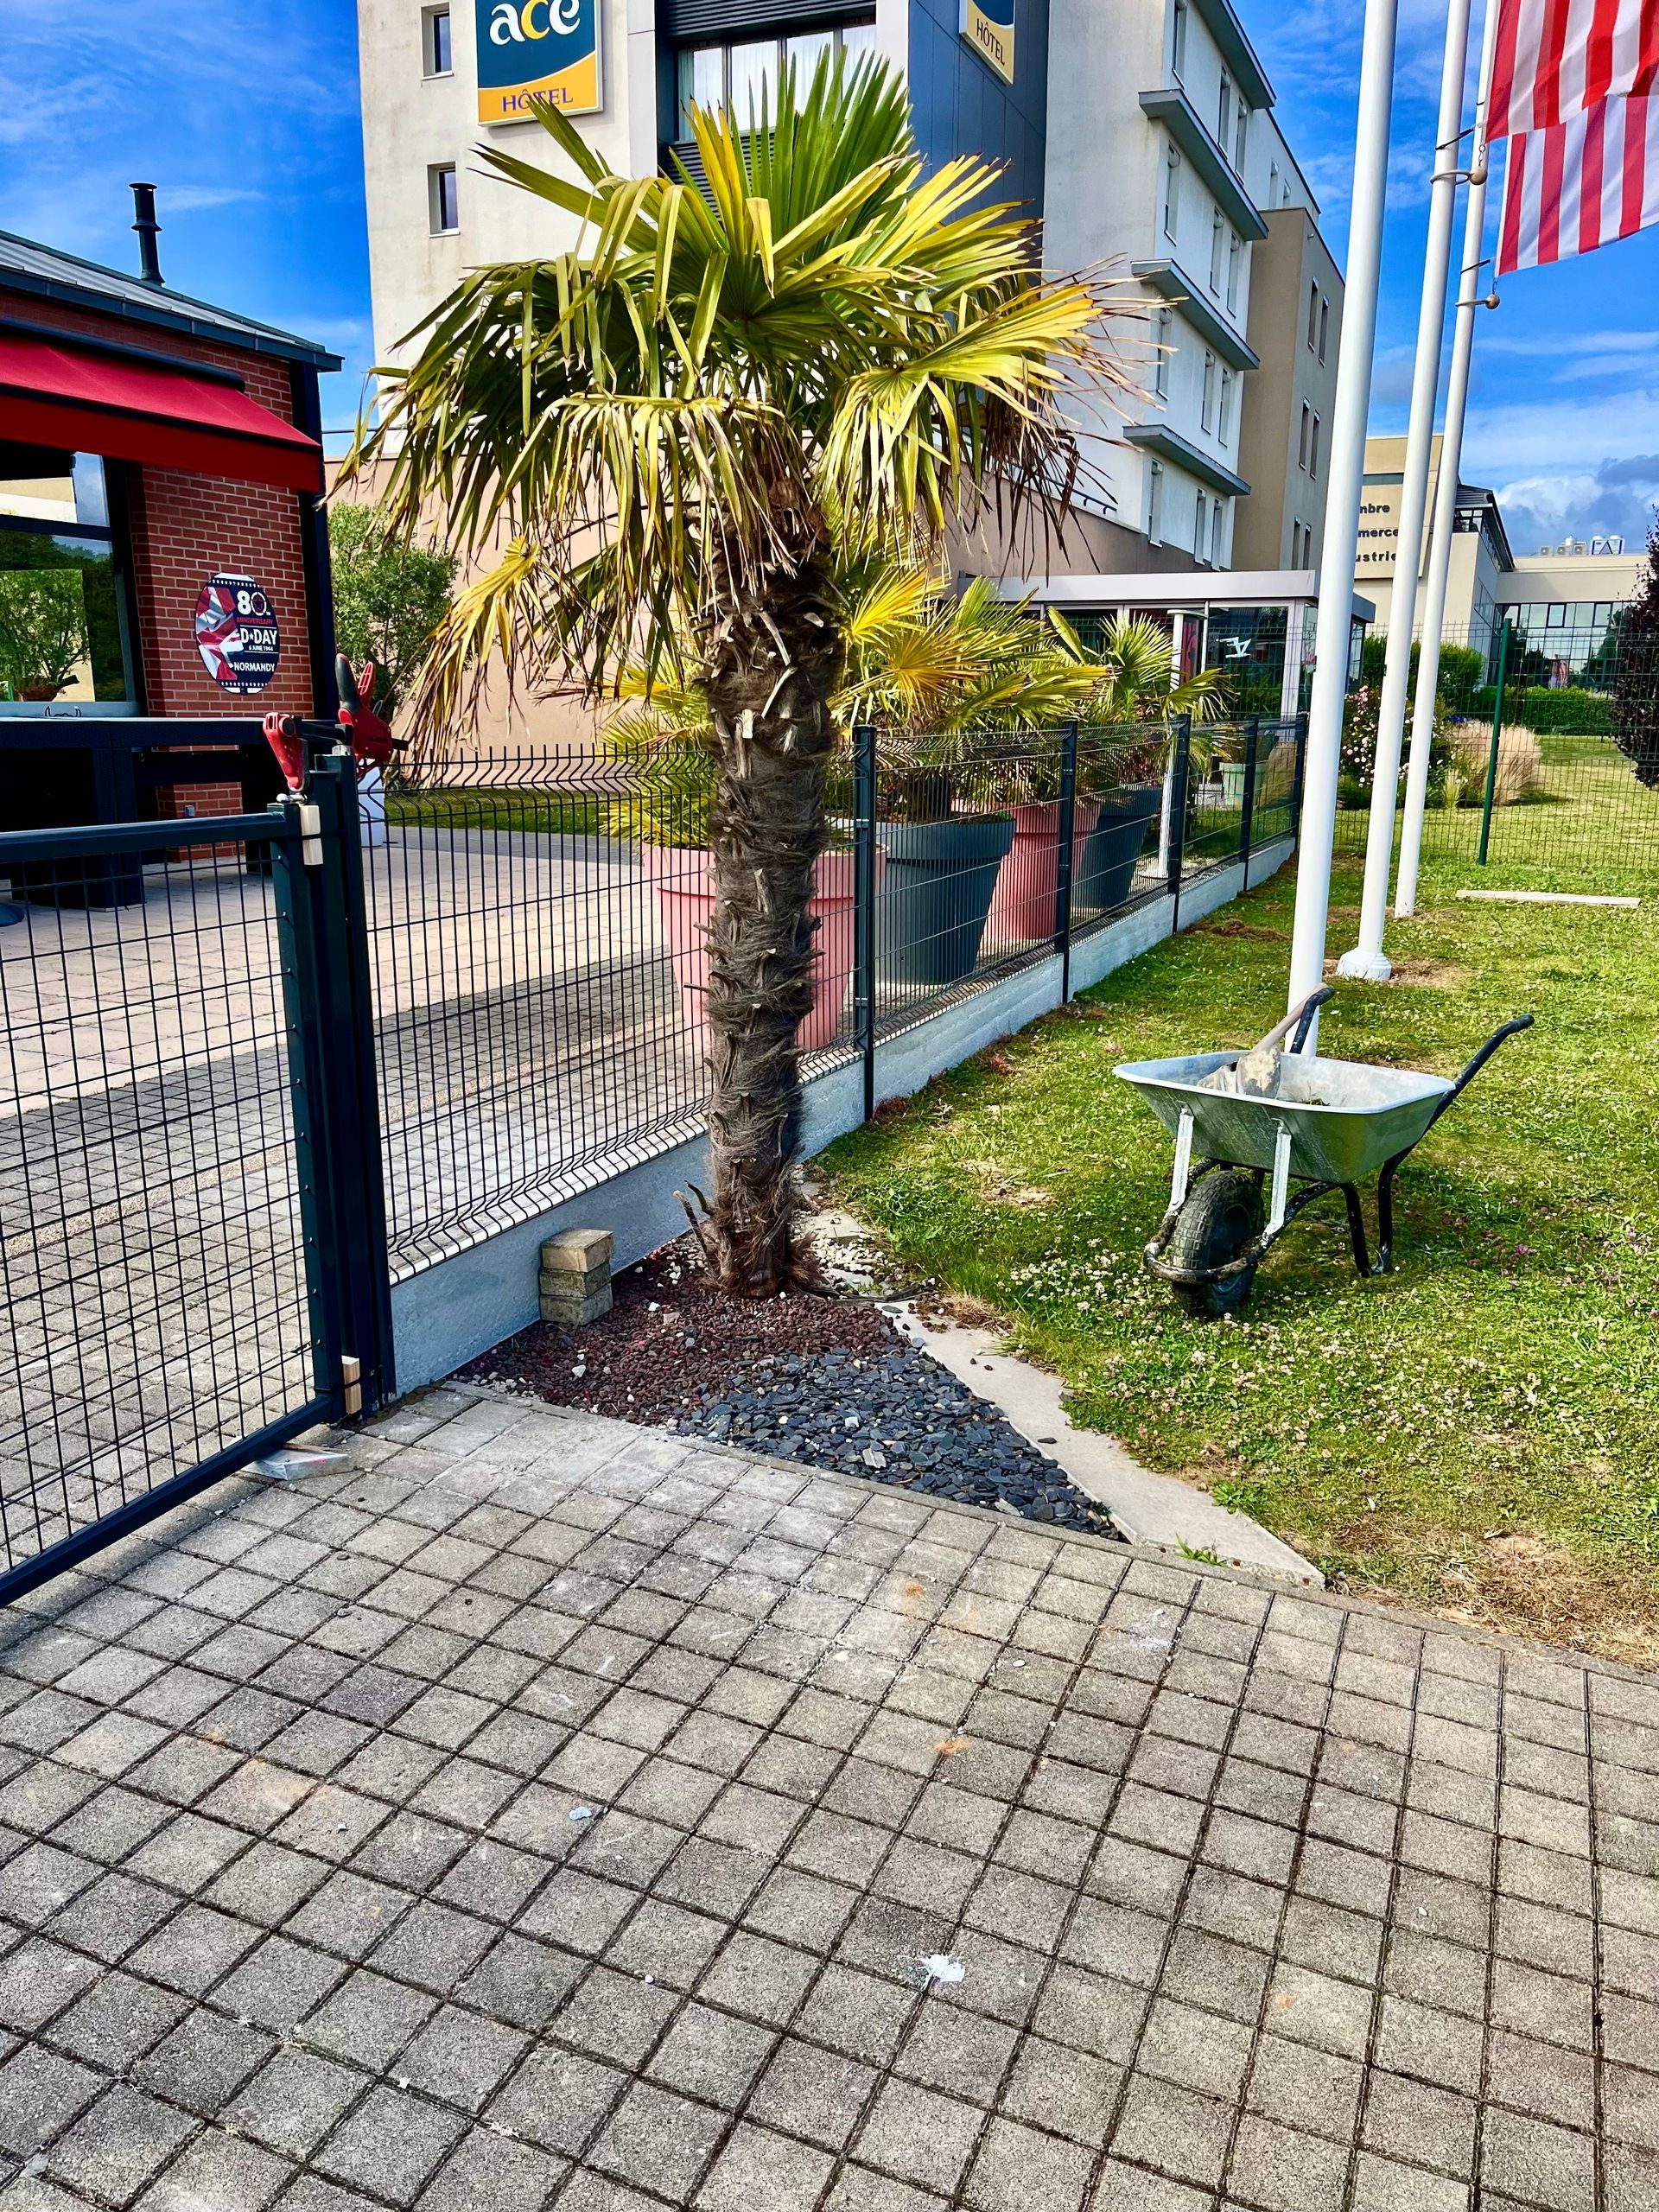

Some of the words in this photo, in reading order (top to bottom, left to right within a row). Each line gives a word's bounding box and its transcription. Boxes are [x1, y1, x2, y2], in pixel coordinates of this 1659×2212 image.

[489, 0, 581, 45] ace
[976, 18, 1005, 66] HÔTEL
[233, 661, 276, 672] NORMANDY
